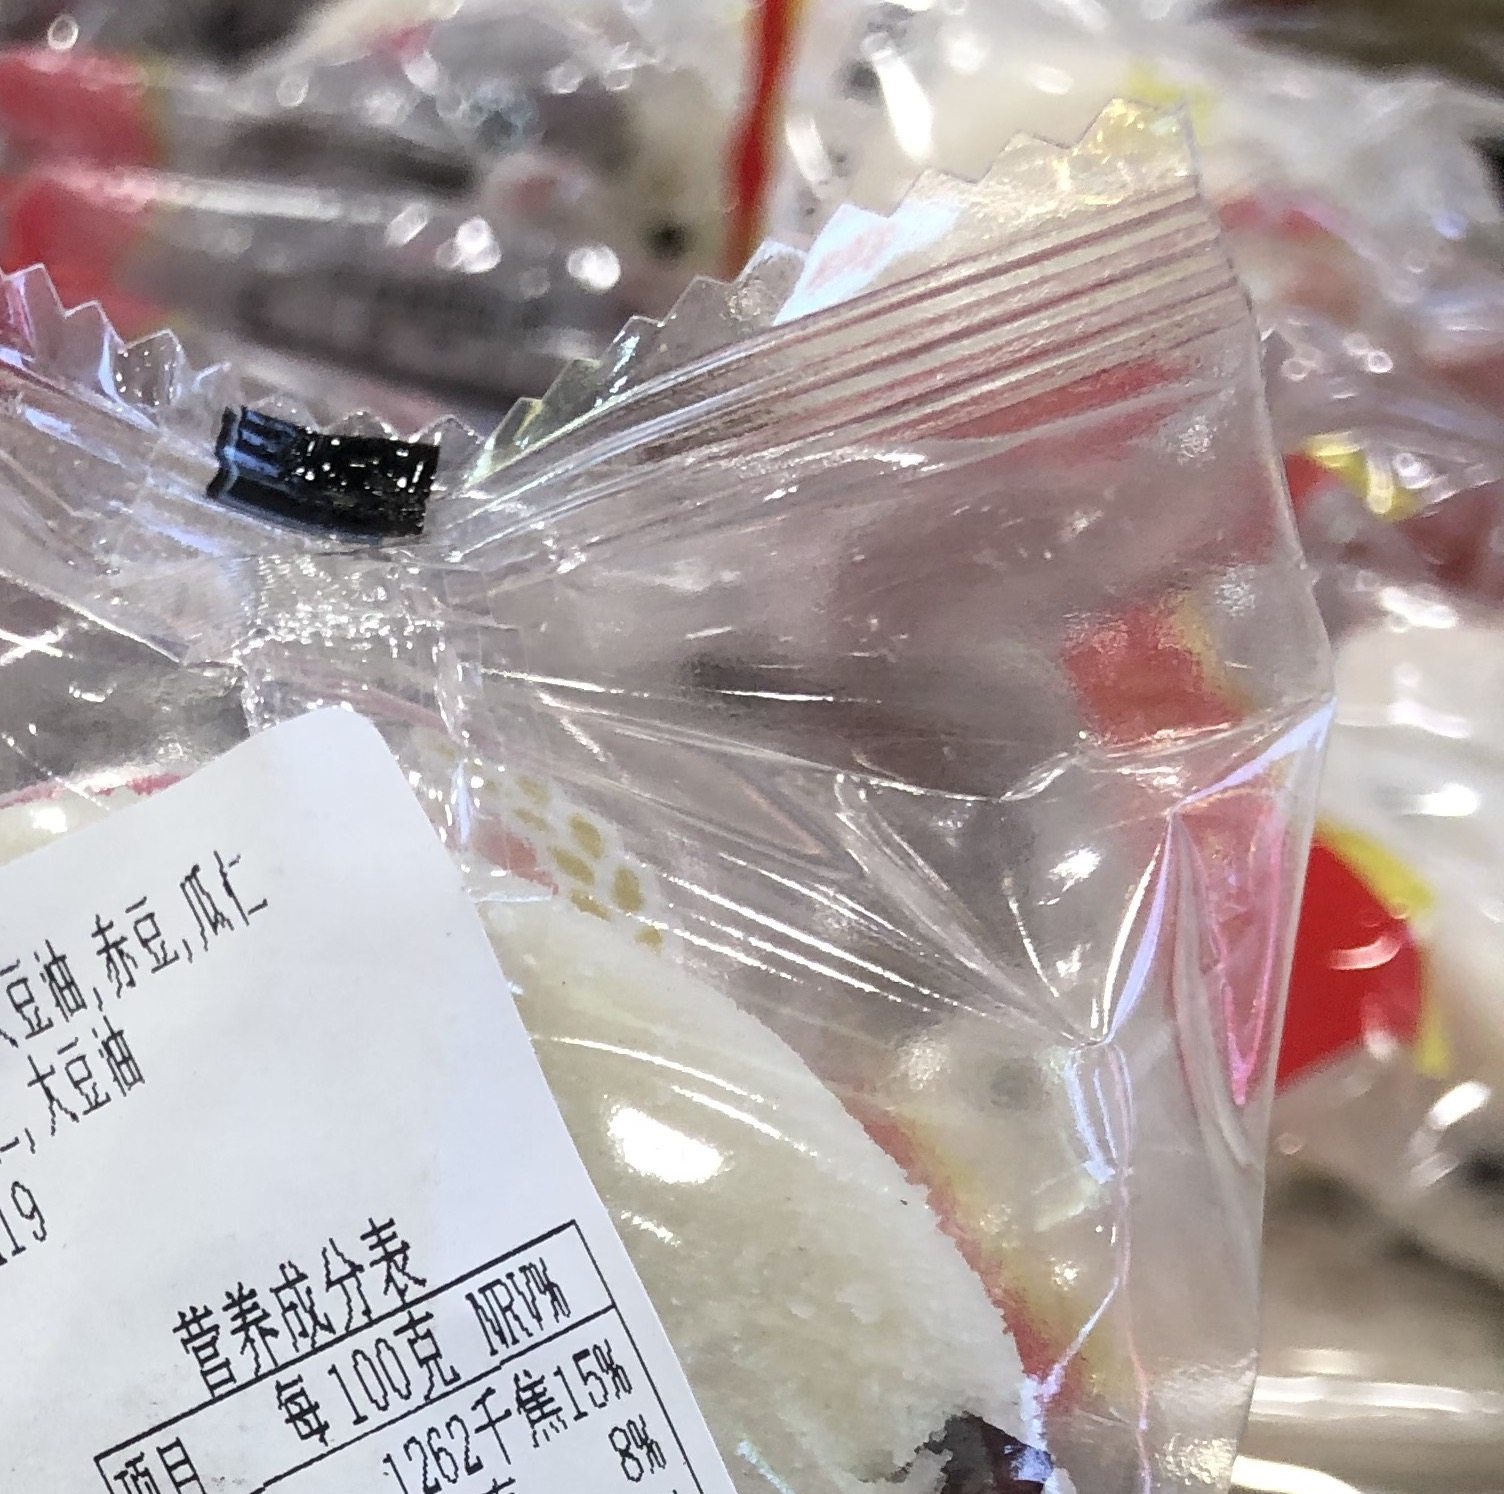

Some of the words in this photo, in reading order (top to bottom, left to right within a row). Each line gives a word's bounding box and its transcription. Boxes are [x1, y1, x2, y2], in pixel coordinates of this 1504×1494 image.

[170, 1215, 429, 1402] 营养成分表
[464, 1256, 573, 1357] NRV%
[605, 1411, 668, 1485] 8%
